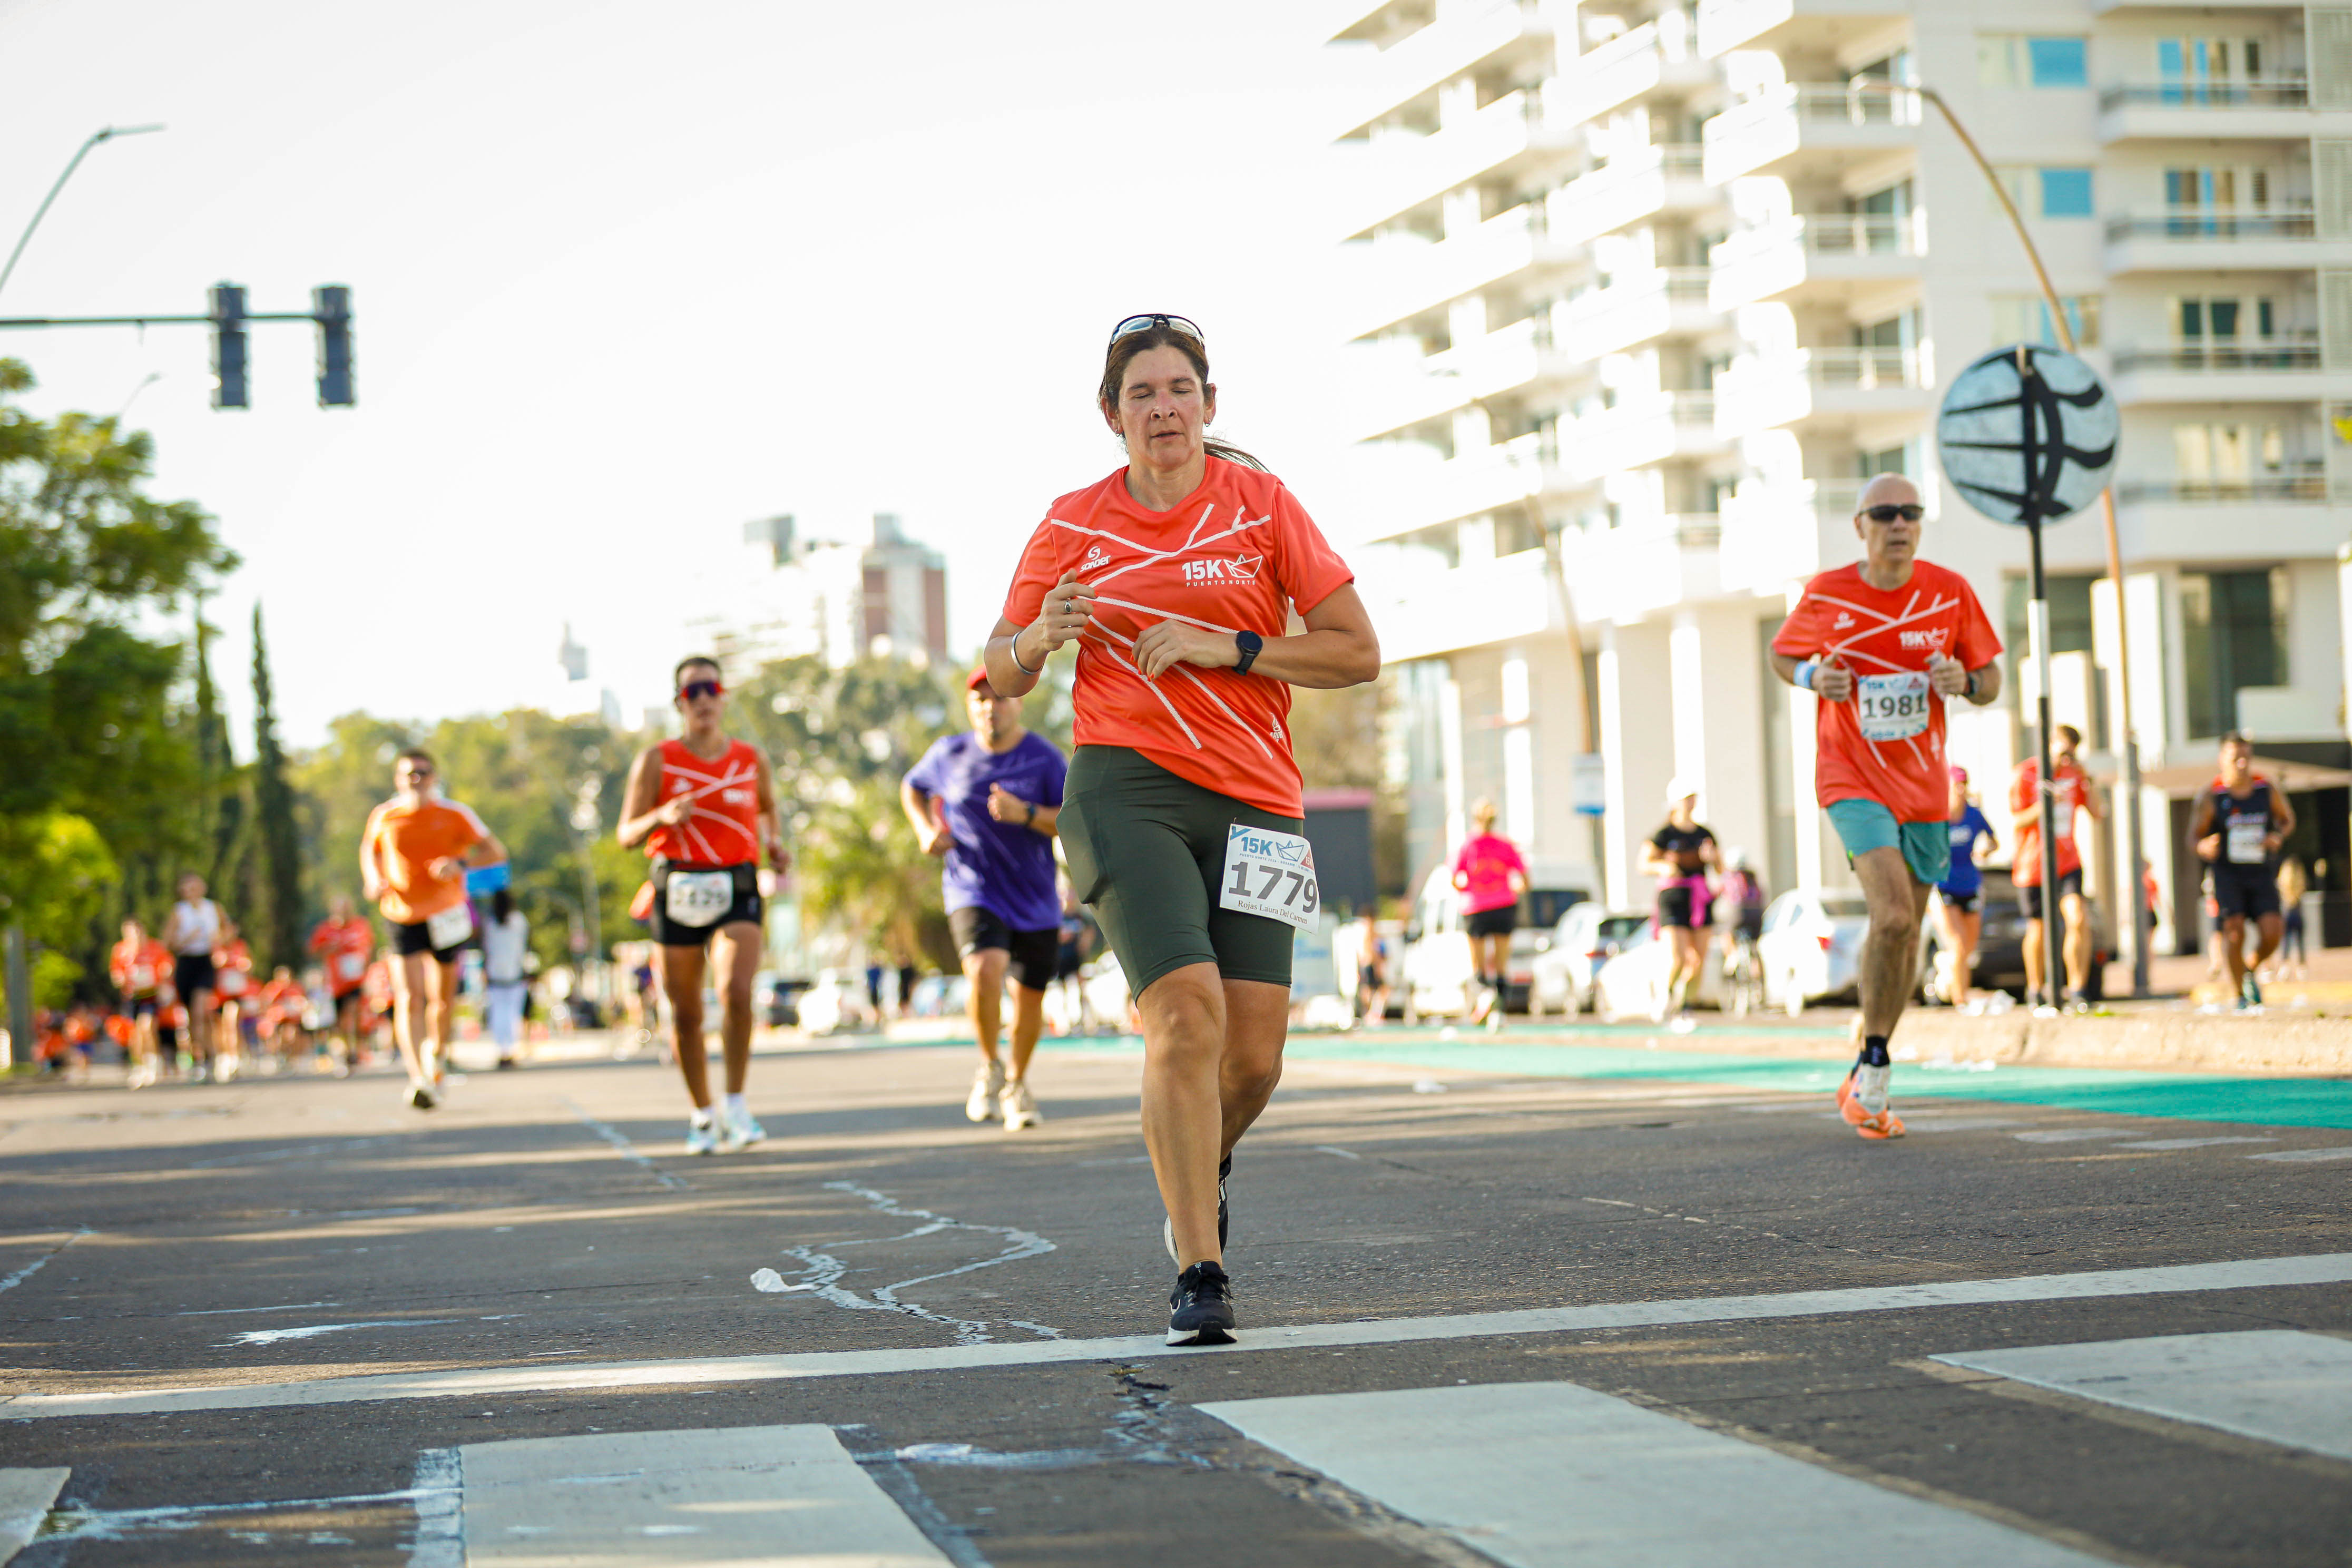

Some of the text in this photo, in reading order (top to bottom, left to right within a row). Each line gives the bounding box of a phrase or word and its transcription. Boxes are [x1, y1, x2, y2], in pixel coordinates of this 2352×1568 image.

[1182, 559, 1224, 580] 15K
[1898, 630, 1926, 646] 15K
[1863, 692, 1927, 718] 1981
[1241, 836, 1273, 856] 15K
[1229, 861, 1317, 913] 1779
[1238, 900, 1308, 924] Rojas Laura Del Carmen
